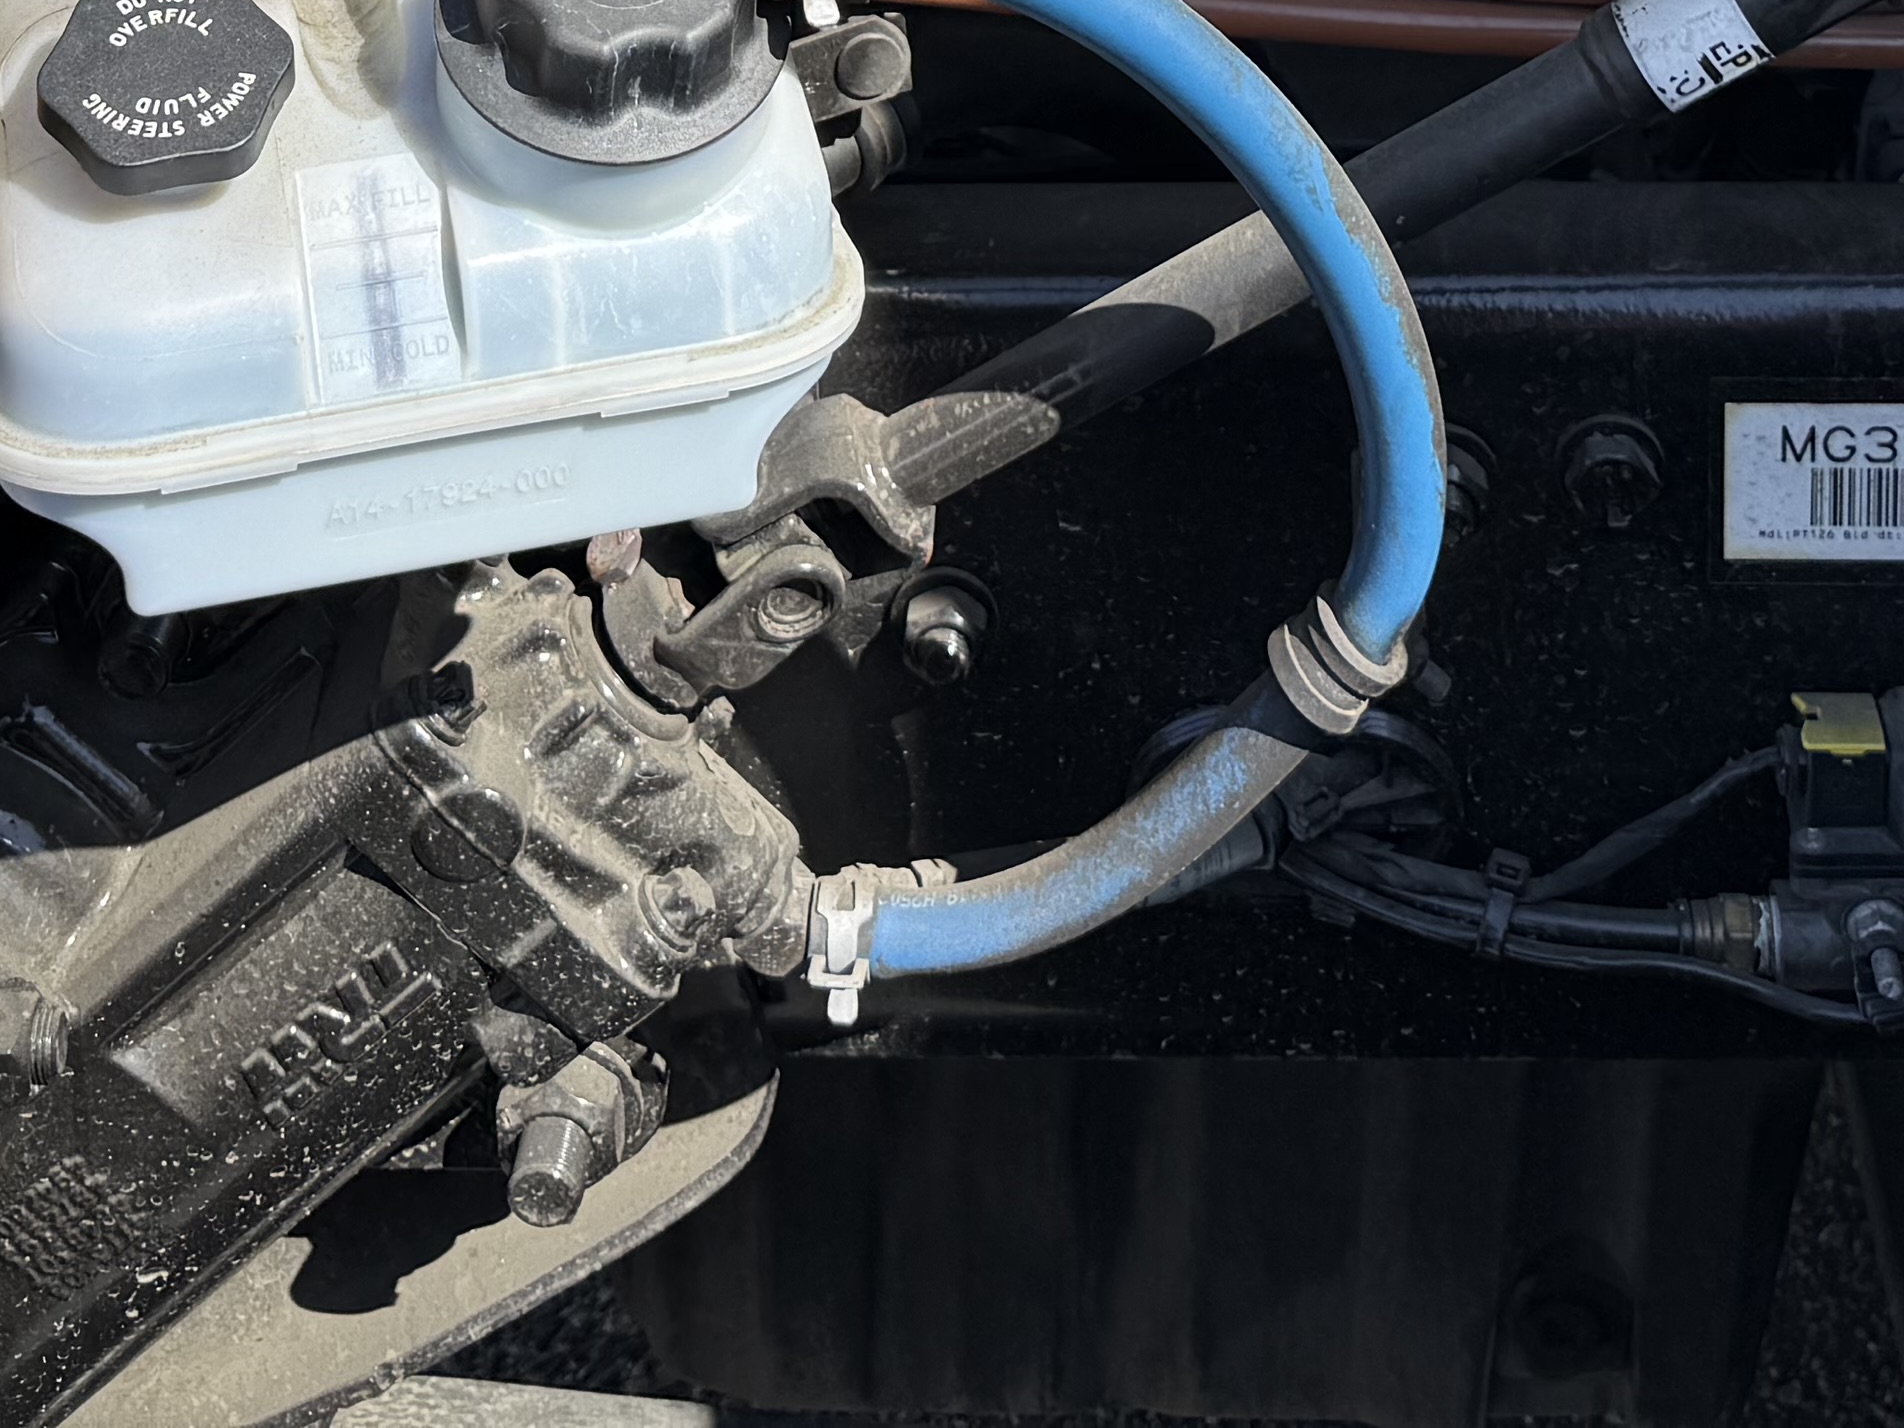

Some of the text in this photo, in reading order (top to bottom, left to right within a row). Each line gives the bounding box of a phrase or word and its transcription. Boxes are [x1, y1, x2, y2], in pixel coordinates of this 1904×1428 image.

[109, 8, 213, 48] OVERFILL
[82, 72, 257, 138] POWER STEERING
[136, 87, 212, 116] FLUID
[306, 183, 431, 222] MAX FILL
[327, 333, 450, 376] MIN COLD
